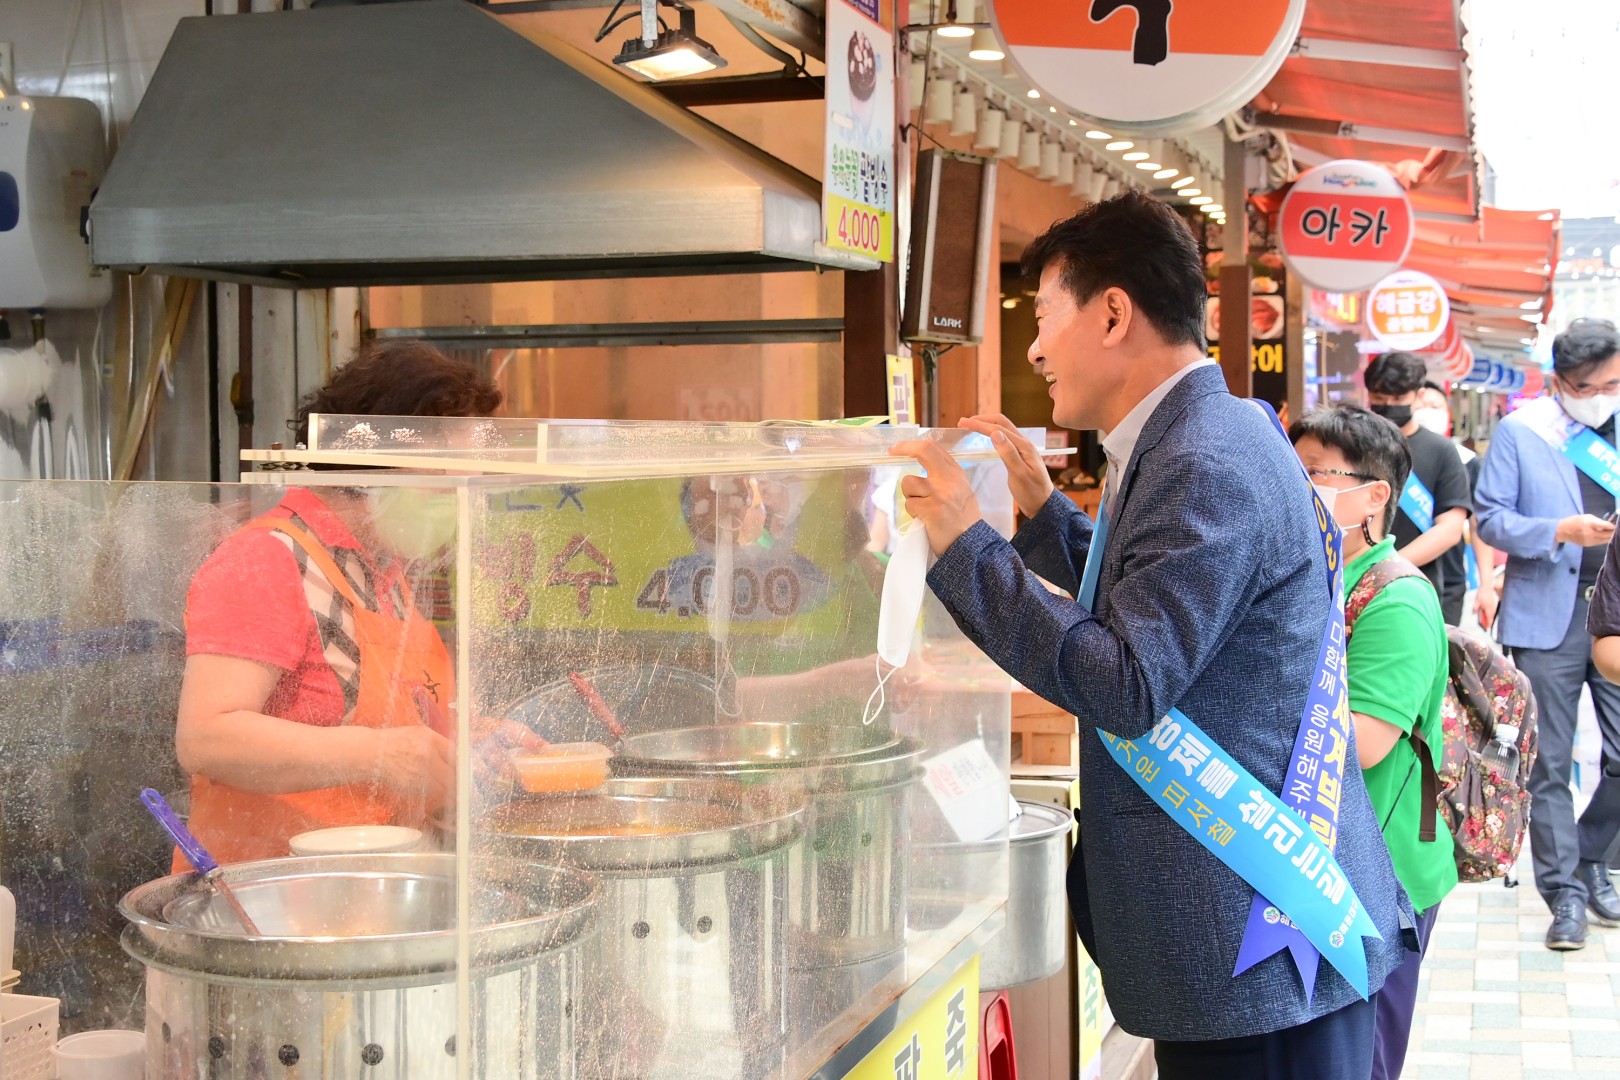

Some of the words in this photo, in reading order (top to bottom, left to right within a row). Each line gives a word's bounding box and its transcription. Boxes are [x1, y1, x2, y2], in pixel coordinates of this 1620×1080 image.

[860, 151, 888, 206] 팥빙수
[1302, 206, 1388, 245] 아카
[933, 316, 962, 329] LARK
[1376, 290, 1437, 315] 해금강
[1317, 620, 1343, 696] 다함께
[1296, 703, 1330, 781] 응원해
[1161, 779, 1237, 847] 피서철
[1288, 778, 1313, 822] 주
